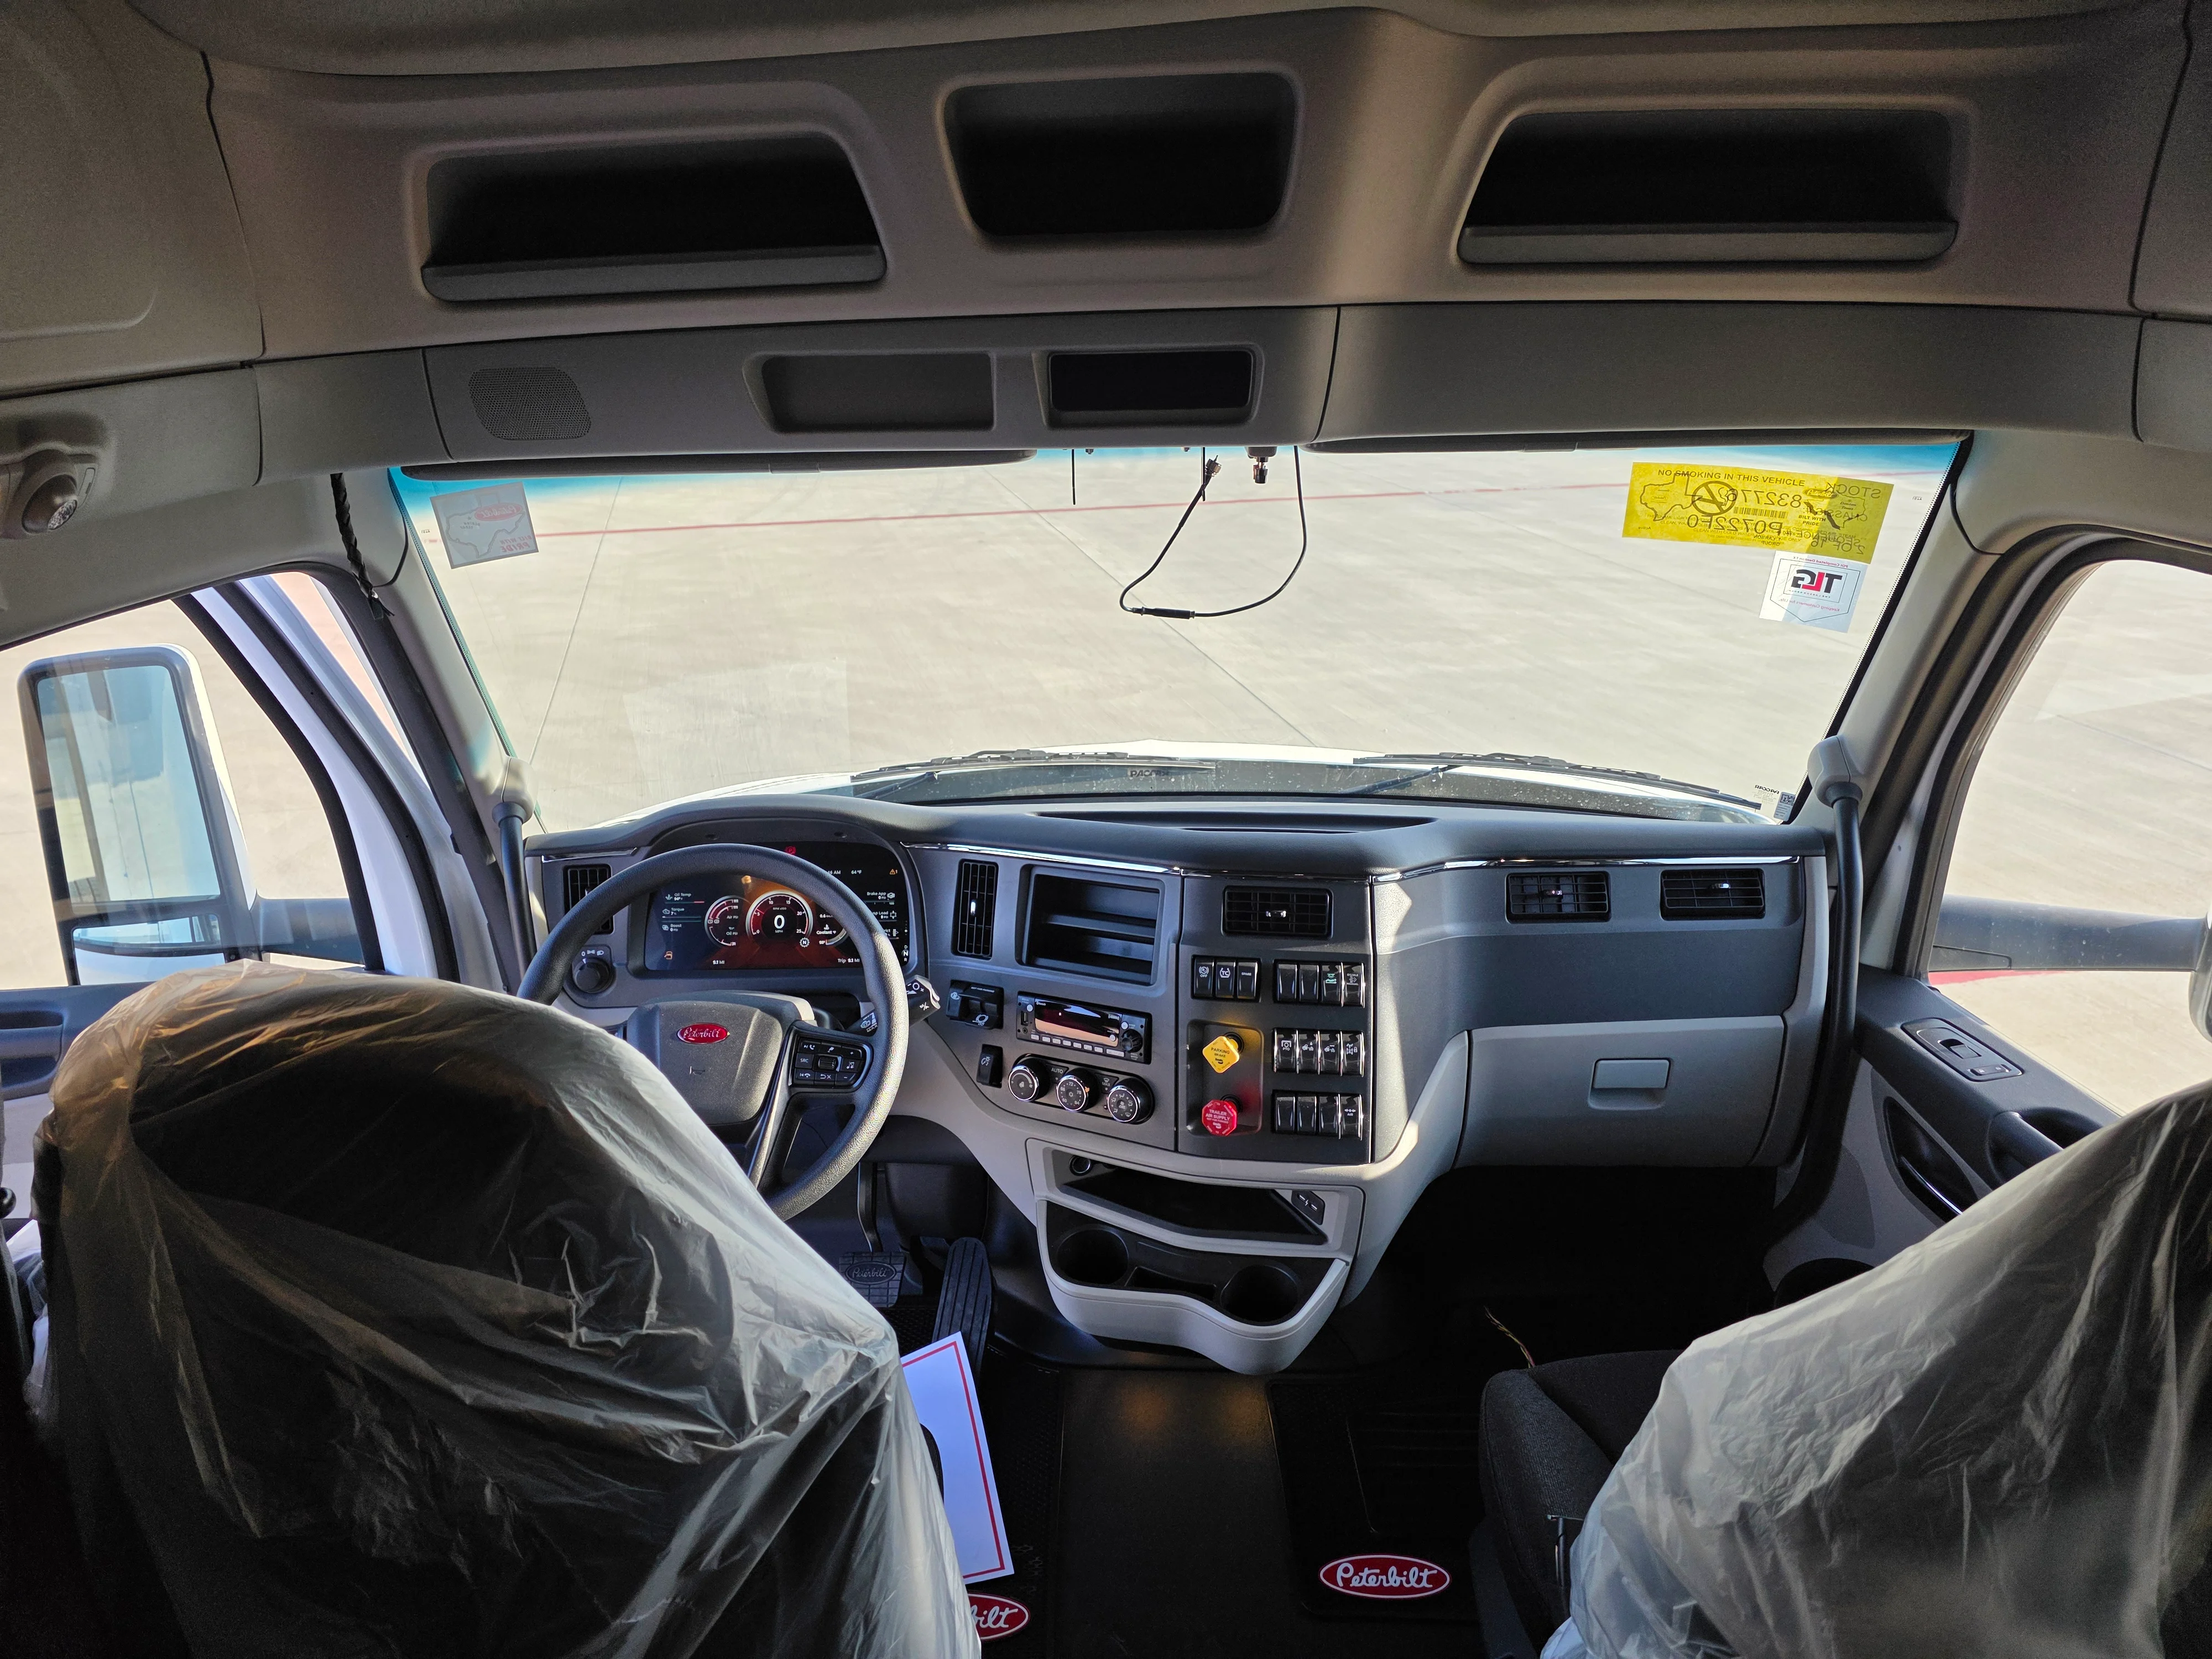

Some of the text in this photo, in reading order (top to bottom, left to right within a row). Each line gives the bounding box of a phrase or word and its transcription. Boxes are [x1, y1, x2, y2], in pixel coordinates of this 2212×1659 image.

[1674, 471, 1720, 479] SMOKING
[1762, 476, 1805, 487] VEHICLE
[774, 915, 785, 929] 0
[684, 1027, 721, 1039] Peterbilt
[852, 1267, 890, 1278] Peterbilt
[1337, 1562, 1438, 1588] Peterbilt
